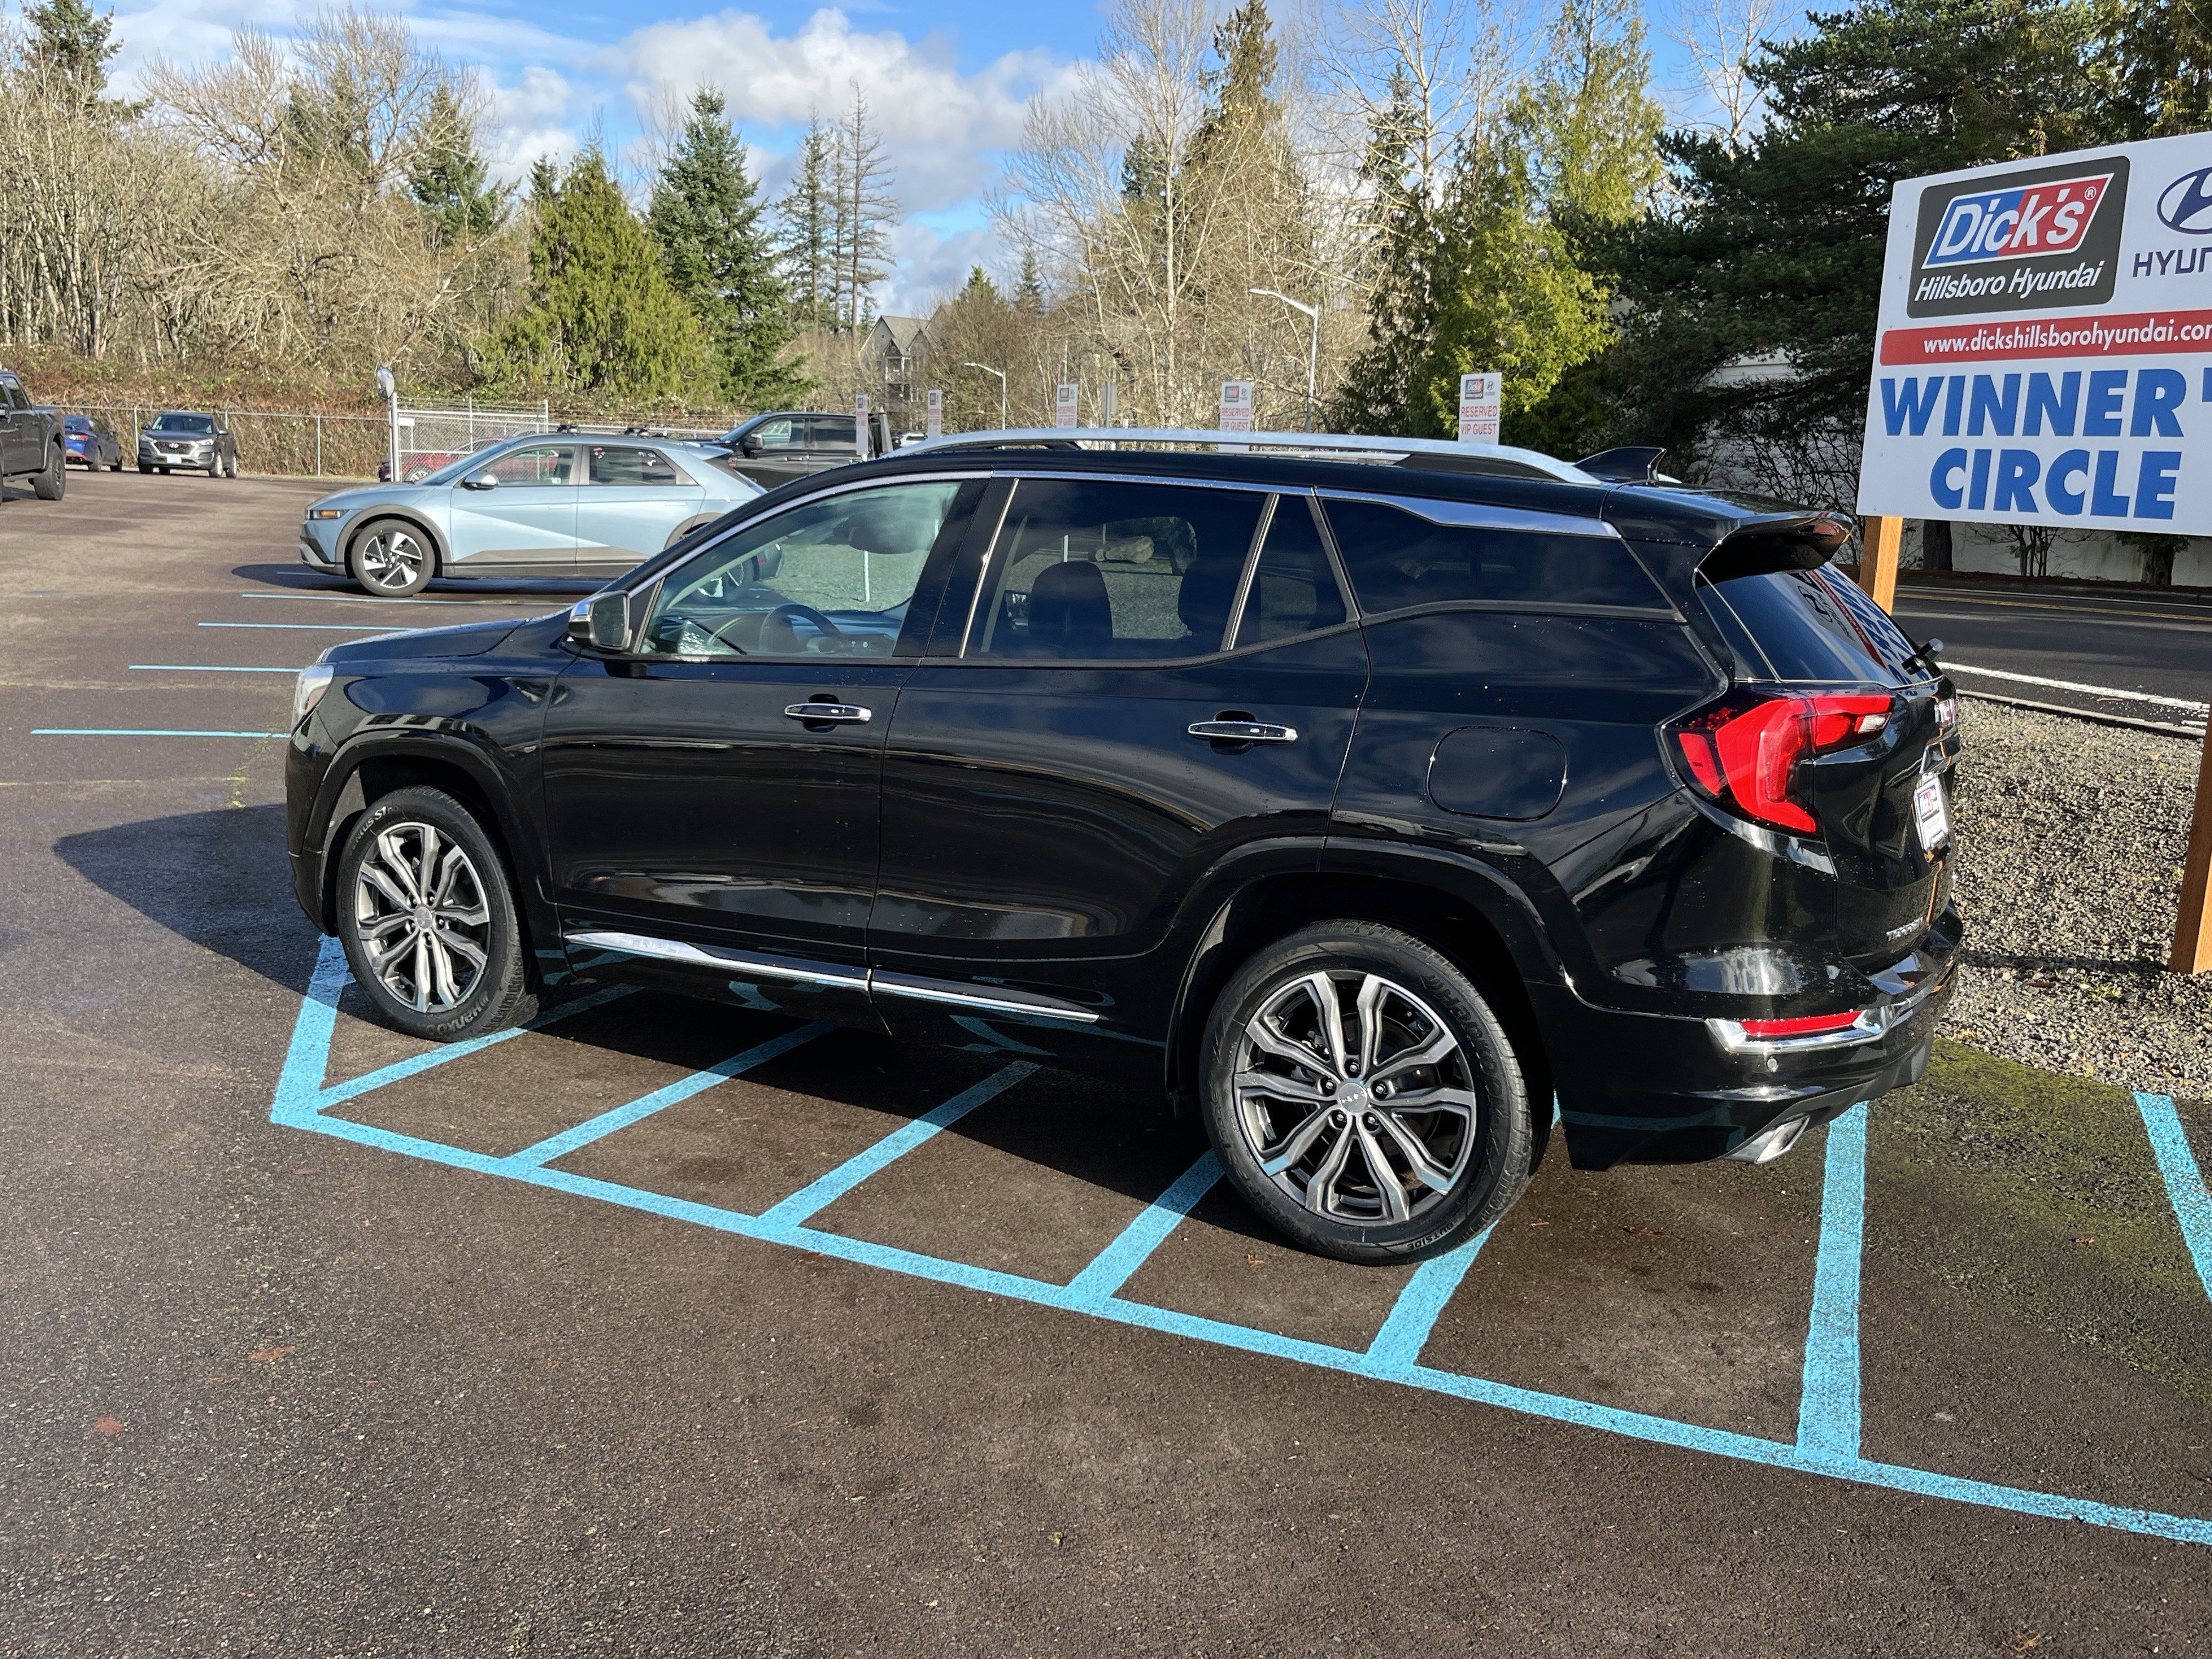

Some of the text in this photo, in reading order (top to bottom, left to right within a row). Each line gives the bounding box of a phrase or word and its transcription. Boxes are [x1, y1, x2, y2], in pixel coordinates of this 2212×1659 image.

[1914, 261, 2105, 302] Hillsboro Hyundai
[1461, 406, 1497, 417] RESERVED
[1461, 423, 1497, 435] VIP GUEST
[1929, 448, 2182, 520] CIRCLE
[1407, 1221, 1454, 1250] OUTSIDE
